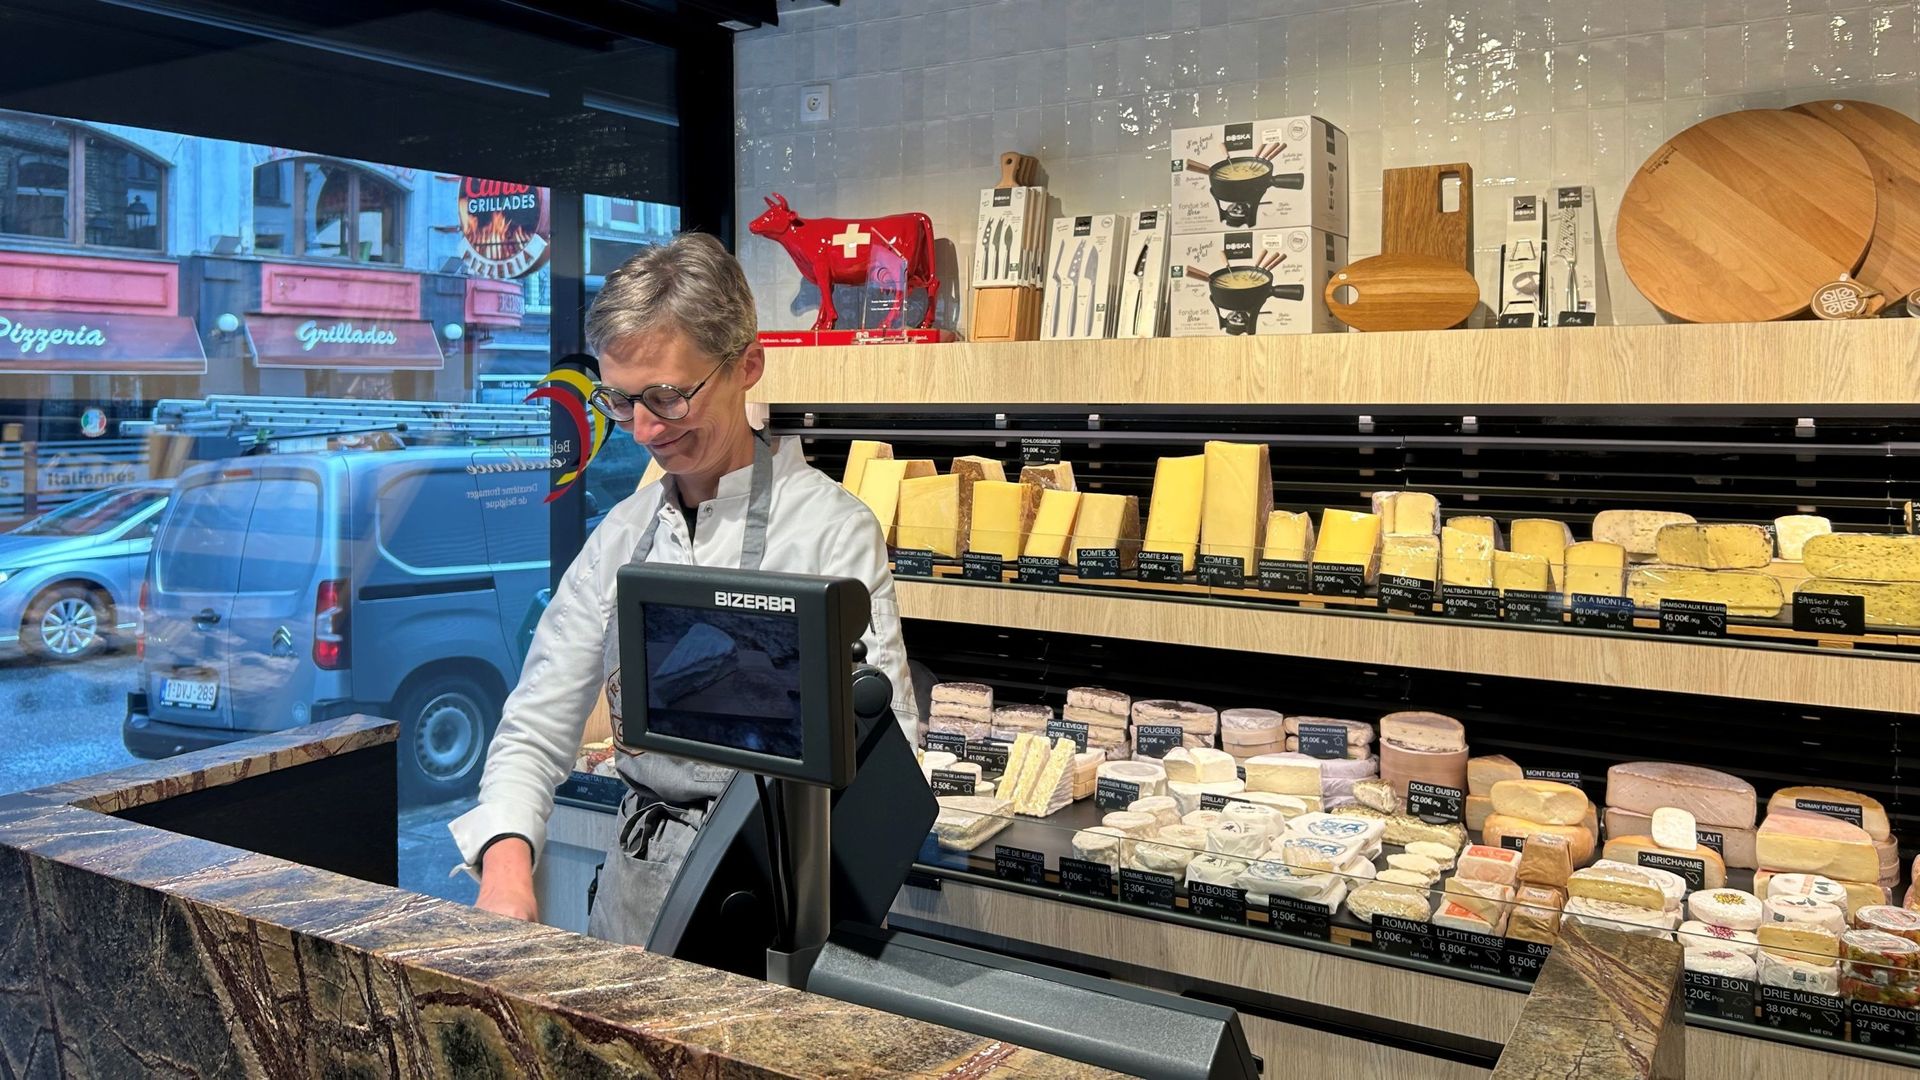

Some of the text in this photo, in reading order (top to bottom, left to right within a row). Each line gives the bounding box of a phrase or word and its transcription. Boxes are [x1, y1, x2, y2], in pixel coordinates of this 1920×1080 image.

[1226, 133, 1251, 142] BOSKA
[469, 194, 535, 213] GRILLADES
[1226, 242, 1251, 250] BOSKA
[463, 250, 533, 279] PIZZERIA
[296, 319, 398, 353] Grillades
[1018, 557, 1059, 566] L'HORLOGER
[1315, 575, 1335, 583] 39.00€
[1381, 587, 1402, 595] 40.00€
[714, 591, 796, 613] BIZERBA
[1573, 595, 1595, 603] LOLA
[1661, 601, 1687, 609] SAMSON
[1798, 596, 1829, 605] SAMSON
[1507, 603, 1530, 611] 40.00€
[1663, 613, 1689, 622] 45.00€
[1139, 726, 1181, 735] FOUGERUS
[1561, 772, 1580, 780] CATS
[932, 782, 950, 790] 3.50€
[1410, 783, 1461, 798] DOLCE GUSTO
[1202, 795, 1224, 804] BRILLAT
[1410, 795, 1433, 805] 42.00€
[1797, 802, 1821, 811] CHIMAY
[995, 847, 1011, 856] BRIE
[1021, 852, 1044, 862] MEAUX
[1062, 870, 1083, 882] 8.00€
[1121, 870, 1174, 886] TOMME VAUDOISE
[1123, 883, 1145, 895] 3.30€
[1193, 883, 1239, 899] LA BOUSE
[1191, 896, 1214, 908] 9.00€
[1270, 897, 1329, 914] TOMME FLEURETTE
[1272, 910, 1296, 922] 9.50€
[1382, 917, 1428, 934] ROMANS
[1375, 930, 1402, 943] 6.00€
[1436, 928, 1445, 937] LI
[1447, 930, 1469, 942] P'TIT
[1440, 942, 1467, 955] 6.80€
[1509, 955, 1537, 969] 8.50€
[1684, 972, 1749, 993] C'EST BON
[1763, 987, 1844, 1010] DRIE MUSSEN
[1766, 1003, 1798, 1017] 38.00€
[1809, 1026, 1822, 1034] Lait
[1856, 1018, 1890, 1032] 37.90€
